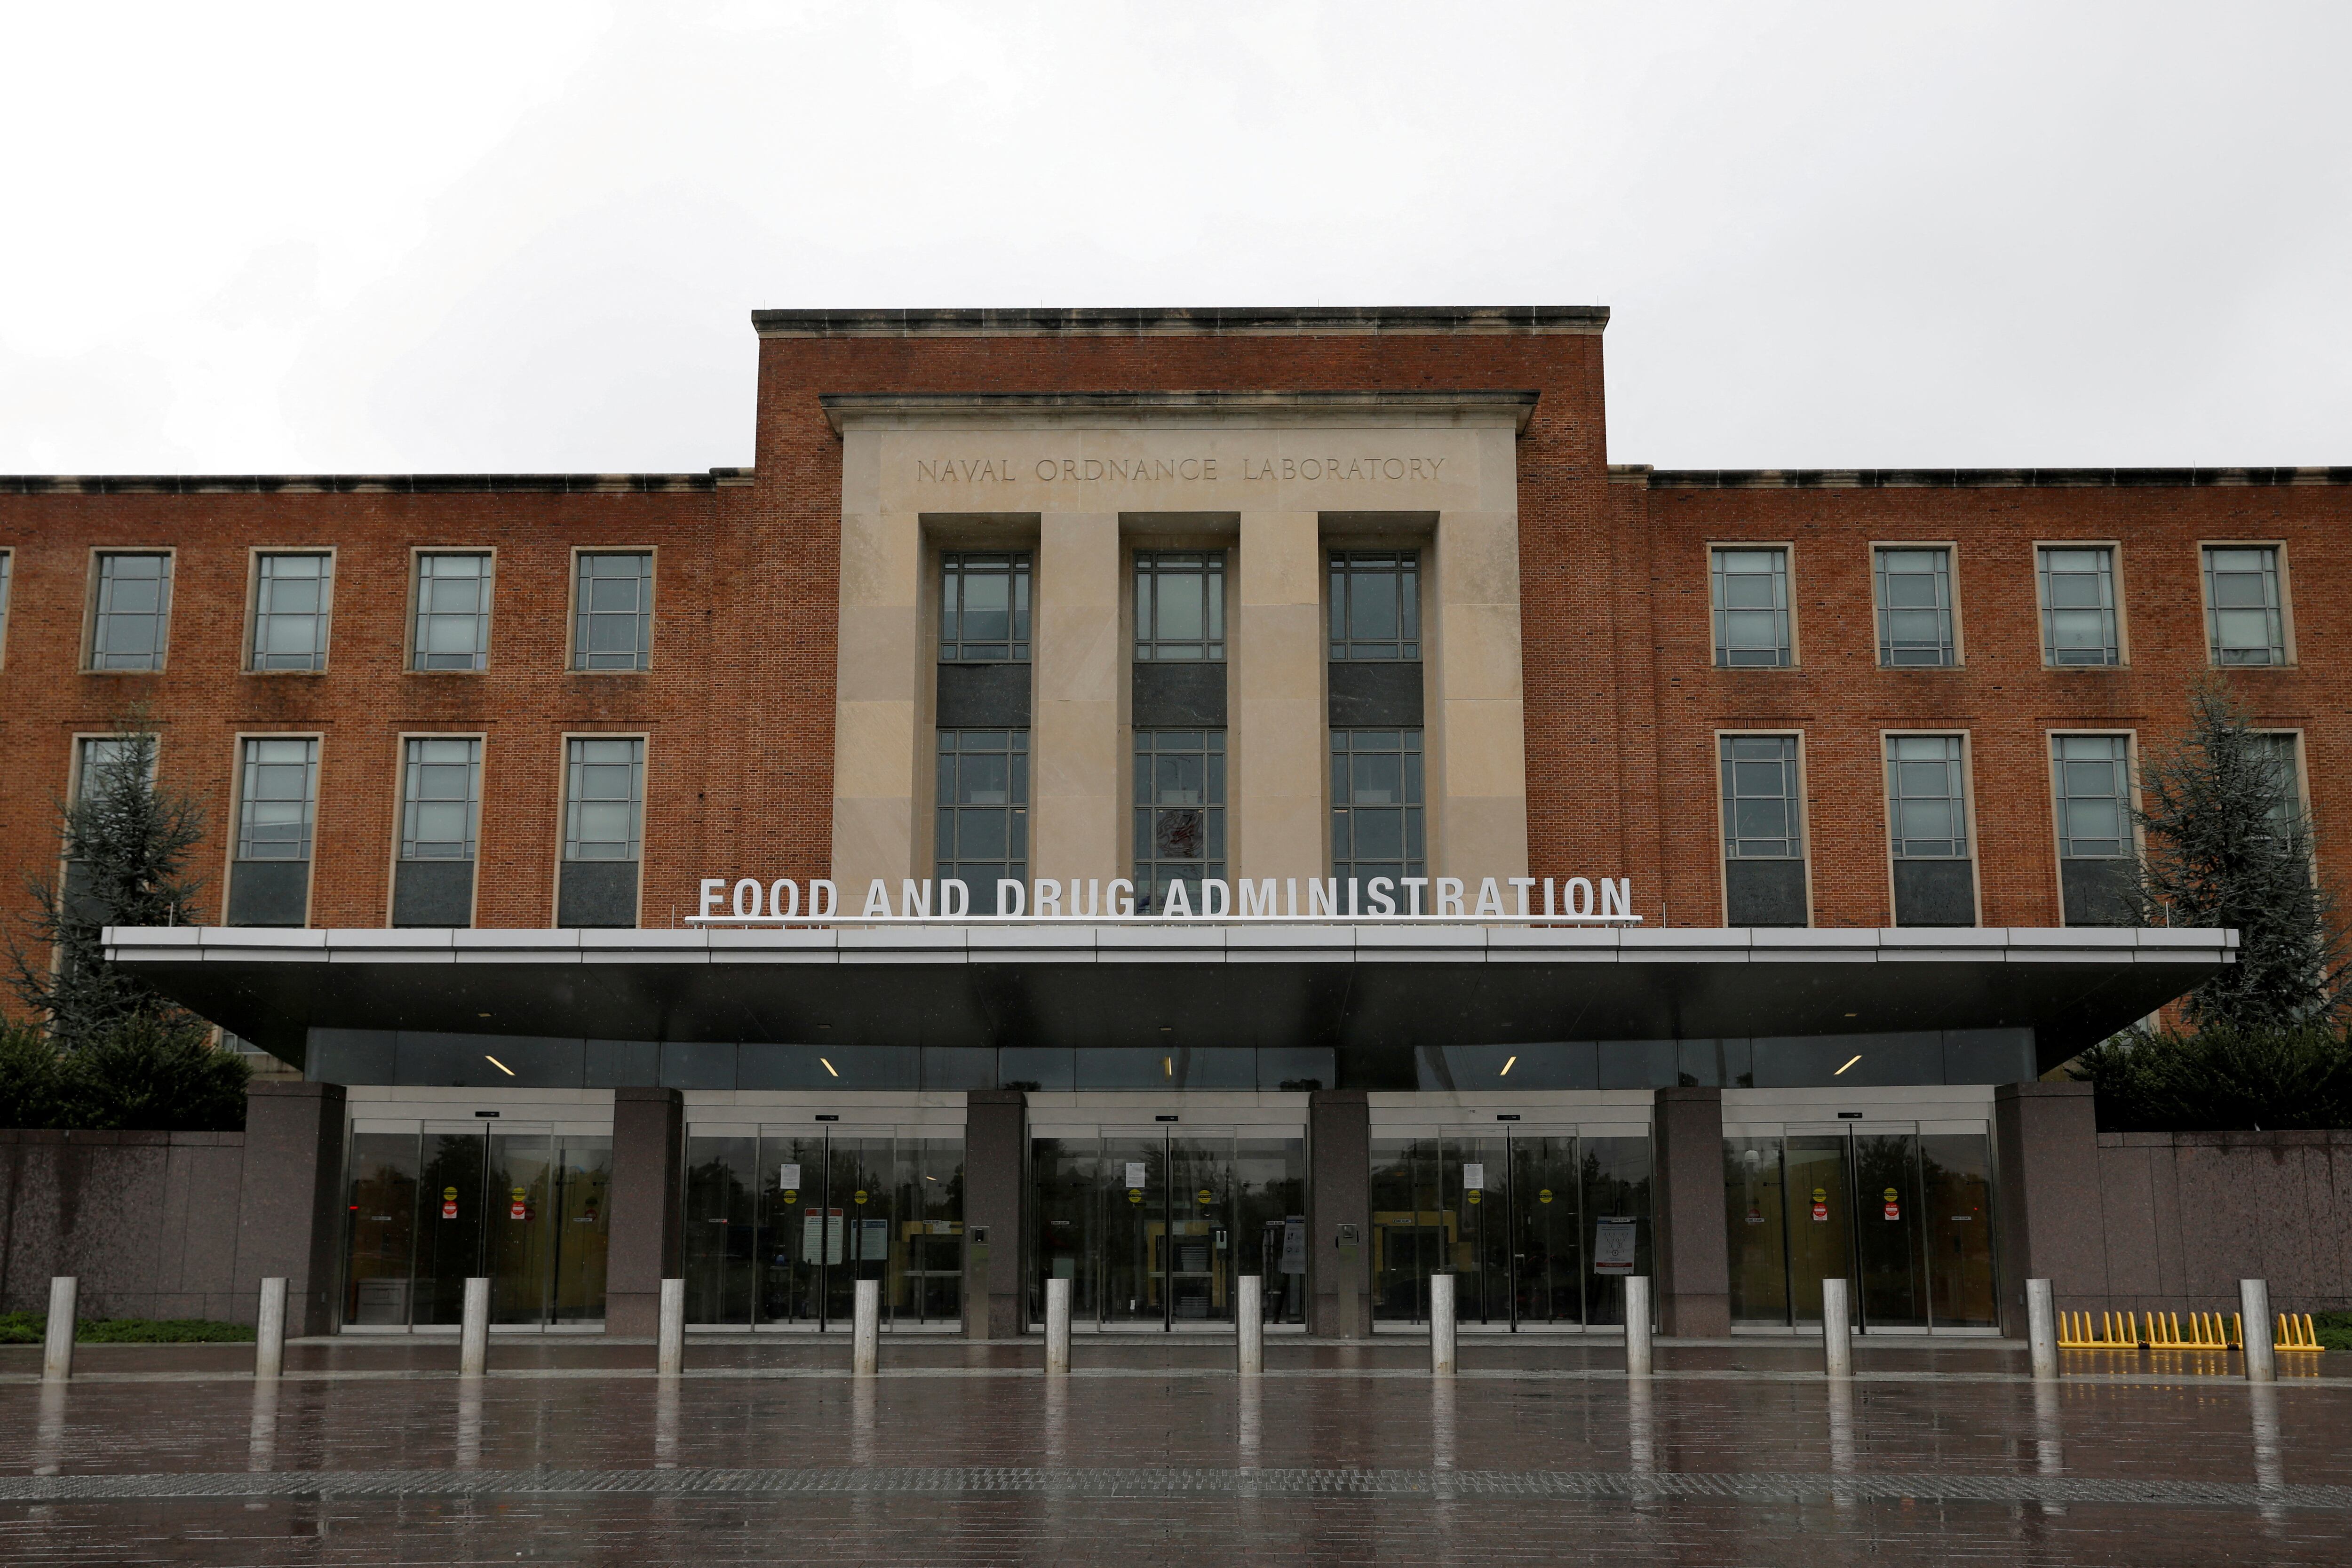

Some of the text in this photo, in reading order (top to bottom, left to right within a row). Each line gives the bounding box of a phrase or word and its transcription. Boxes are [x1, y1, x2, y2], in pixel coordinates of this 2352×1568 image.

[917, 457, 1446, 483] NAVAL ORDNANCE LABORATORY
[699, 876, 1631, 917] FOOD AND DRUG ADMINISTRATION
